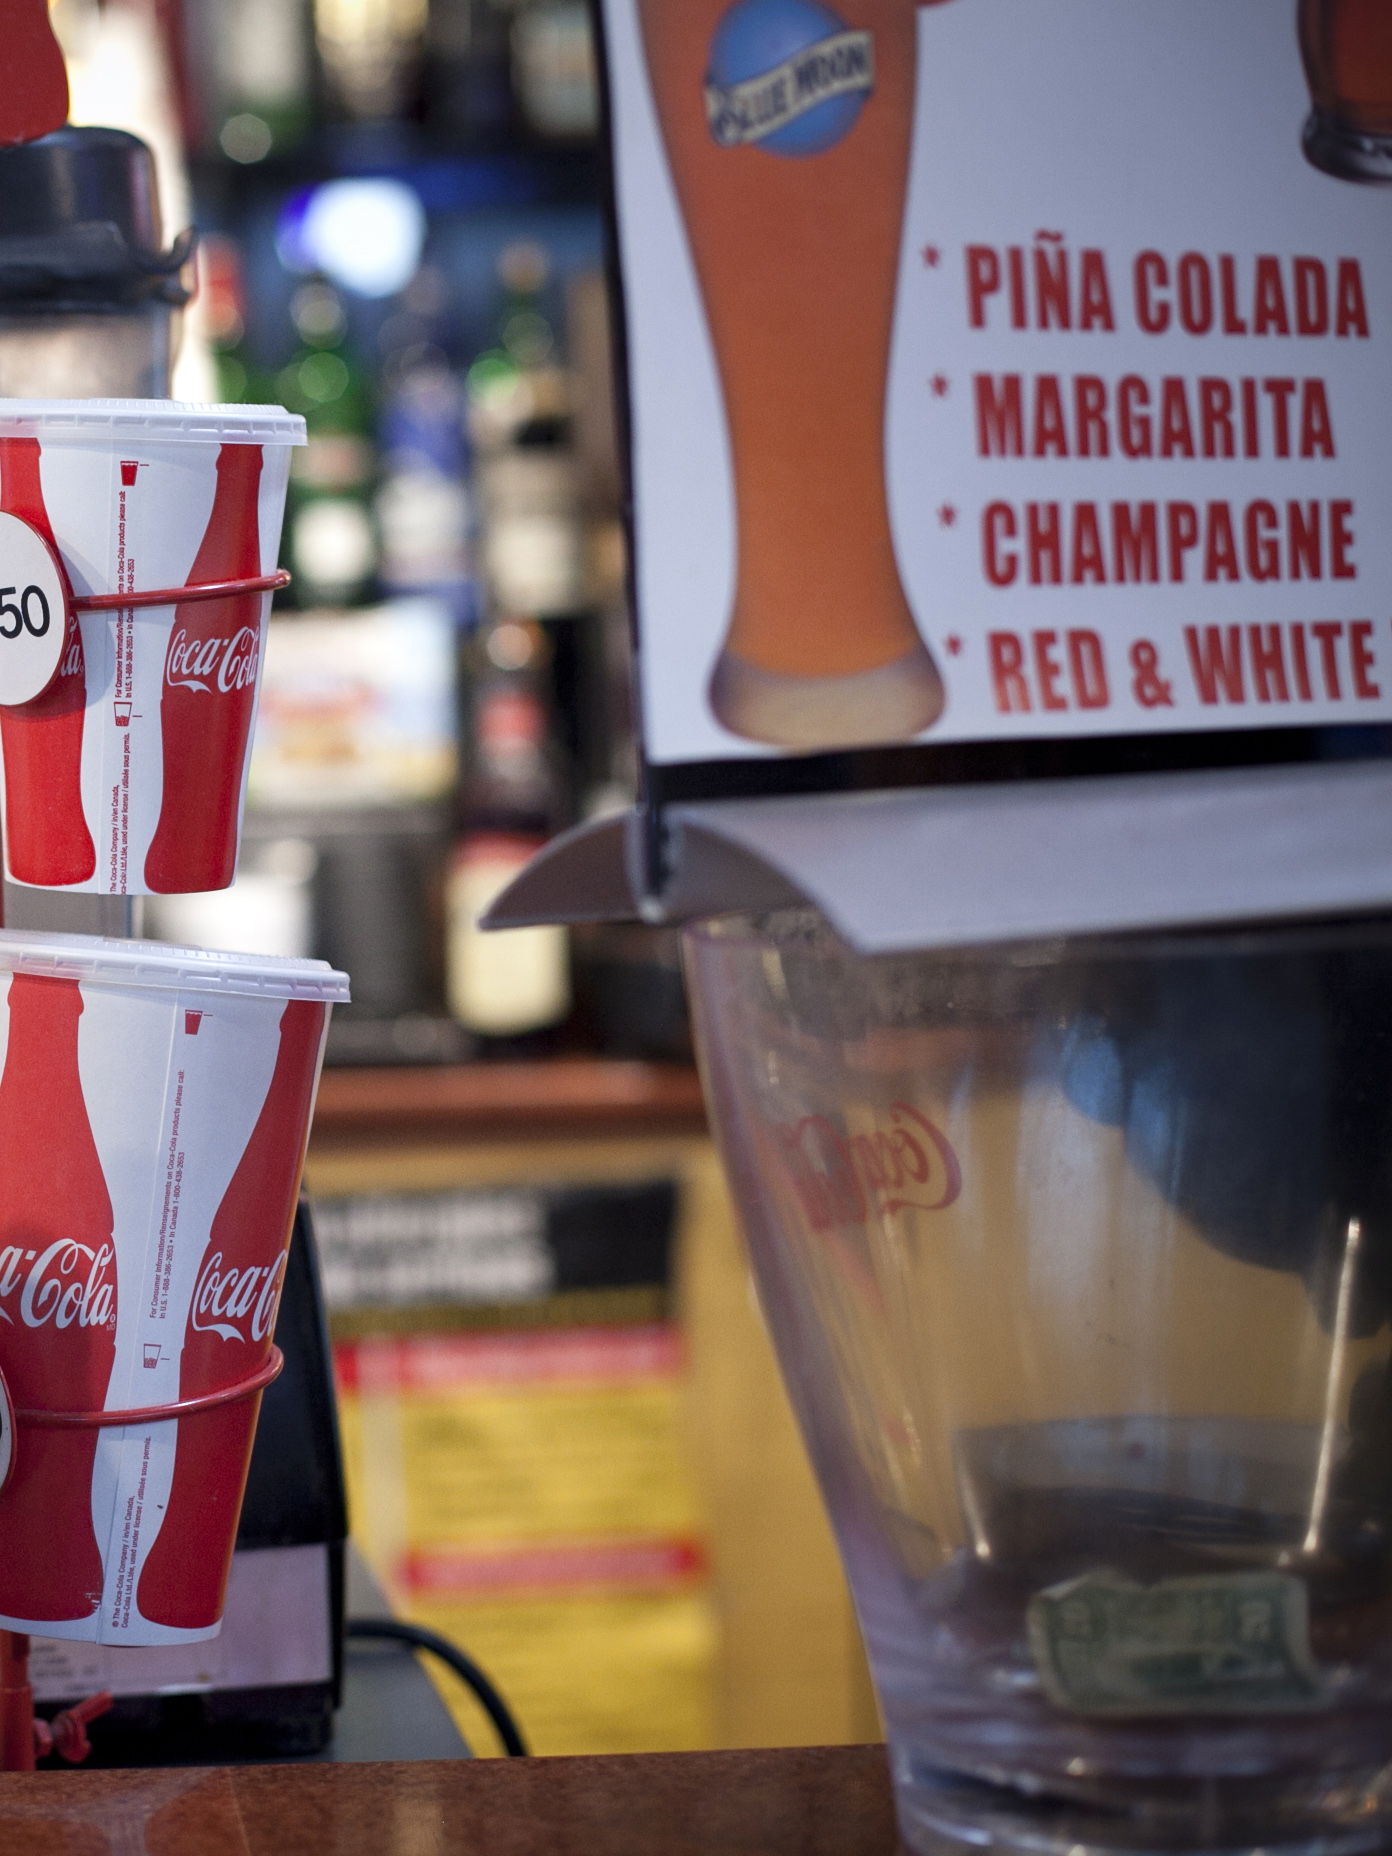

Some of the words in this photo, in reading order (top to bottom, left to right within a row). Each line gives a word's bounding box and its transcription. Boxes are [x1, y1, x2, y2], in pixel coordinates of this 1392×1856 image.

[963, 229, 1117, 333] PIÑA
[1132, 249, 1370, 338] COLADA
[972, 372, 1336, 460] MARGARITA
[118, 504, 126, 521] please
[118, 522, 126, 546] products
[980, 499, 1358, 587] CHAMPAGNE
[117, 547, 125, 574] Coca-Cola
[115, 660, 123, 688] Consumer
[166, 626, 260, 694] Coca-Cola
[987, 628, 1111, 714] RED
[1128, 638, 1175, 708] &
[1182, 619, 1381, 705] WHITE
[121, 794, 129, 813] license
[110, 827, 119, 852] Company
[110, 853, 118, 881] Coca-Cola
[174, 1085, 183, 1106] please
[172, 1107, 180, 1136] products
[166, 1137, 177, 1170] Coca-Cola
[166, 1171, 173, 1180] on
[173, 1152, 185, 1204] 1-800-438-2653
[155, 1181, 172, 1273] Information/Renseignements
[169, 1206, 178, 1230] Canada
[161, 1245, 174, 1297] 1-888-386-2653
[150, 1274, 161, 1307] Consumer
[191, 1248, 288, 1344] Coca-C
[149, 1307, 157, 1319] For
[160, 1299, 168, 1312] U.S.
[138, 1478, 146, 1500] utilisée
[124, 1496, 135, 1521] Canada,
[133, 1506, 142, 1528] license
[131, 1530, 139, 1547] under
[118, 1544, 129, 1573] Company
[129, 1549, 137, 1564] used
[114, 1575, 125, 1606] Coca-Cola
[113, 1608, 121, 1619] The
[121, 1596, 131, 1628] Coca-Cola
